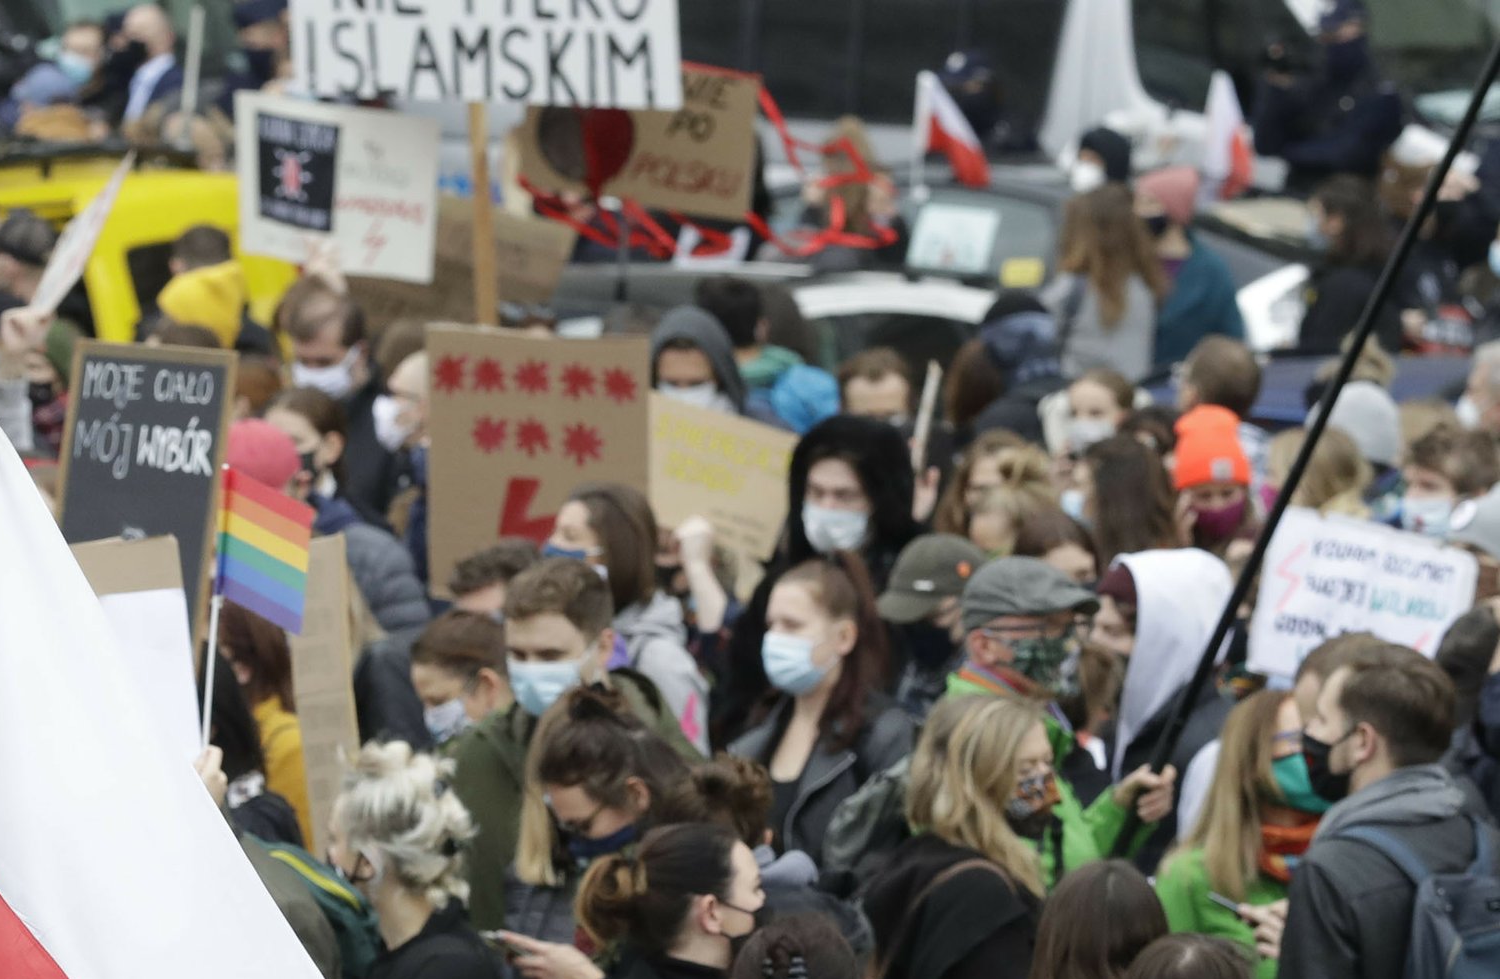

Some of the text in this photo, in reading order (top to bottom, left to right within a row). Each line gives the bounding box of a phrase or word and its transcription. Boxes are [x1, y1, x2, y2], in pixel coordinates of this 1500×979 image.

[304, 20, 656, 108] ISLAMSKIM
[82, 361, 146, 410] MOJE
[73, 411, 134, 480] MÓJ
